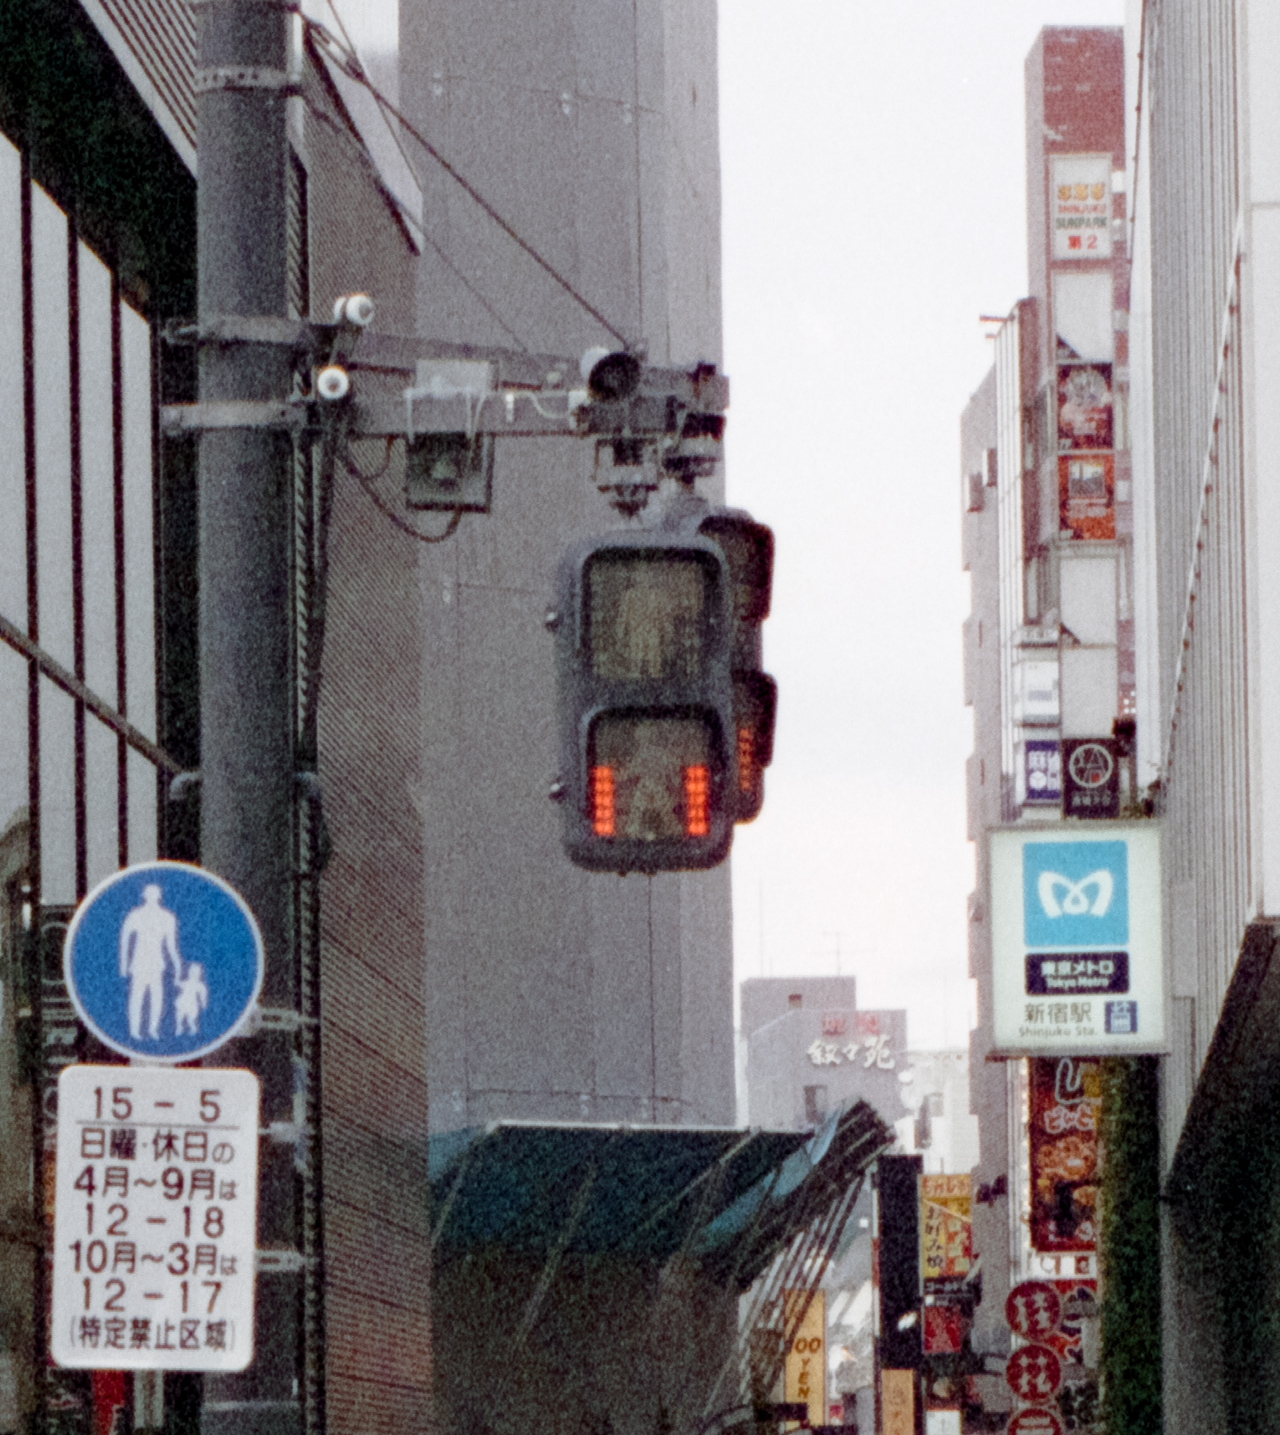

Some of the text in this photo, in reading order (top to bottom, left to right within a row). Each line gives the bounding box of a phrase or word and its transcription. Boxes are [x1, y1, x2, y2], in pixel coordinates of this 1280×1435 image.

[1041, 960, 1114, 976] 東京メトロ
[1046, 976, 1109, 989] Tokyo Metro
[1024, 1001, 1092, 1024] 新宿駅
[1019, 1026, 1071, 1038] Shinjuku
[70, 1316, 236, 1353] (特定禁止区域)
